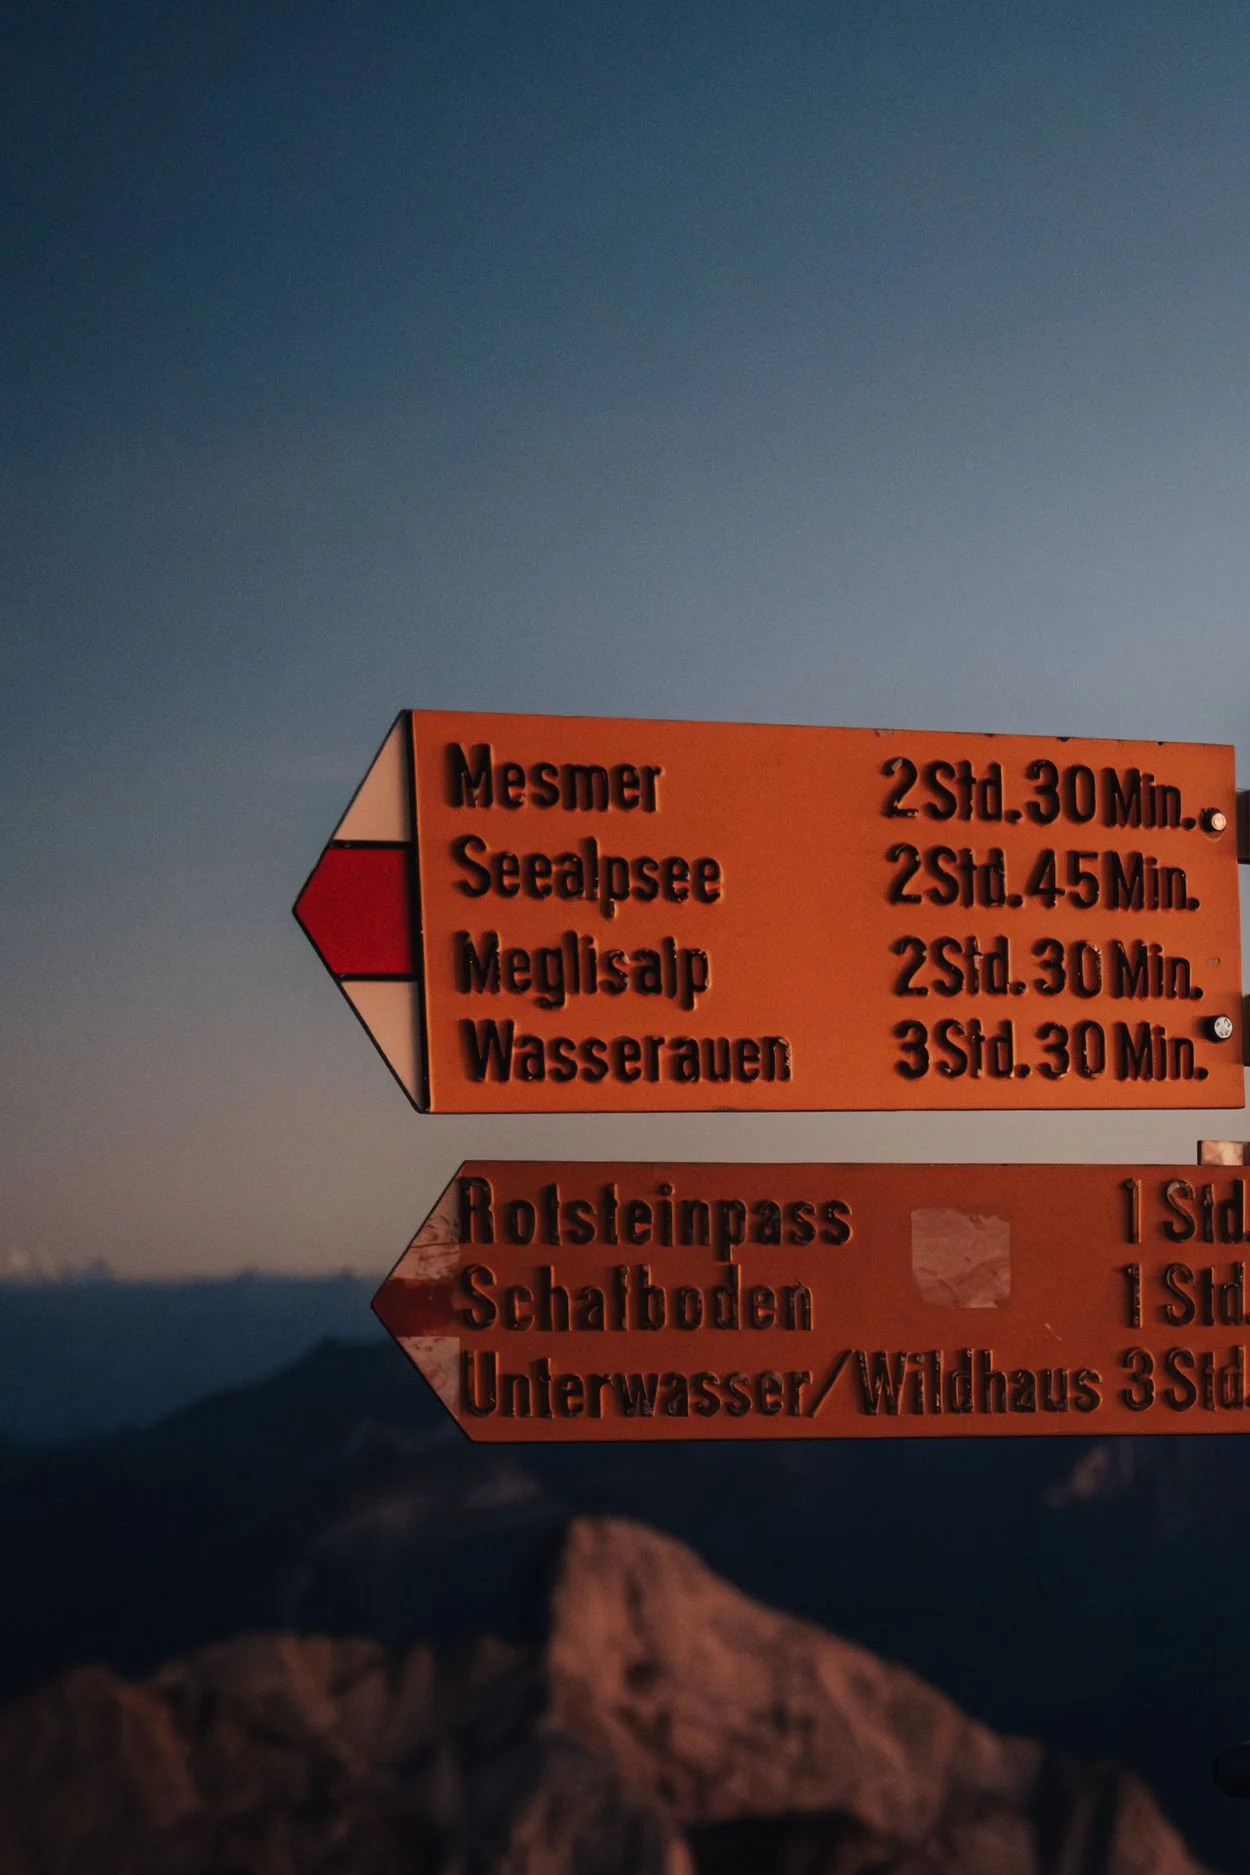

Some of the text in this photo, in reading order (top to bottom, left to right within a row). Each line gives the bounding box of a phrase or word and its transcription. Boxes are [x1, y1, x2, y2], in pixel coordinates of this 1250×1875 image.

[446, 742, 663, 812] Mesmer
[451, 835, 723, 919] Seealpsee
[453, 931, 711, 1011] Meglisalp
[460, 1018, 792, 1083] Wasserauen
[457, 1177, 853, 1262] Rotsteinpass
[1121, 1178, 1142, 1244] 1
[458, 1264, 814, 1332] Schafboden
[1123, 1262, 1143, 1328] 1
